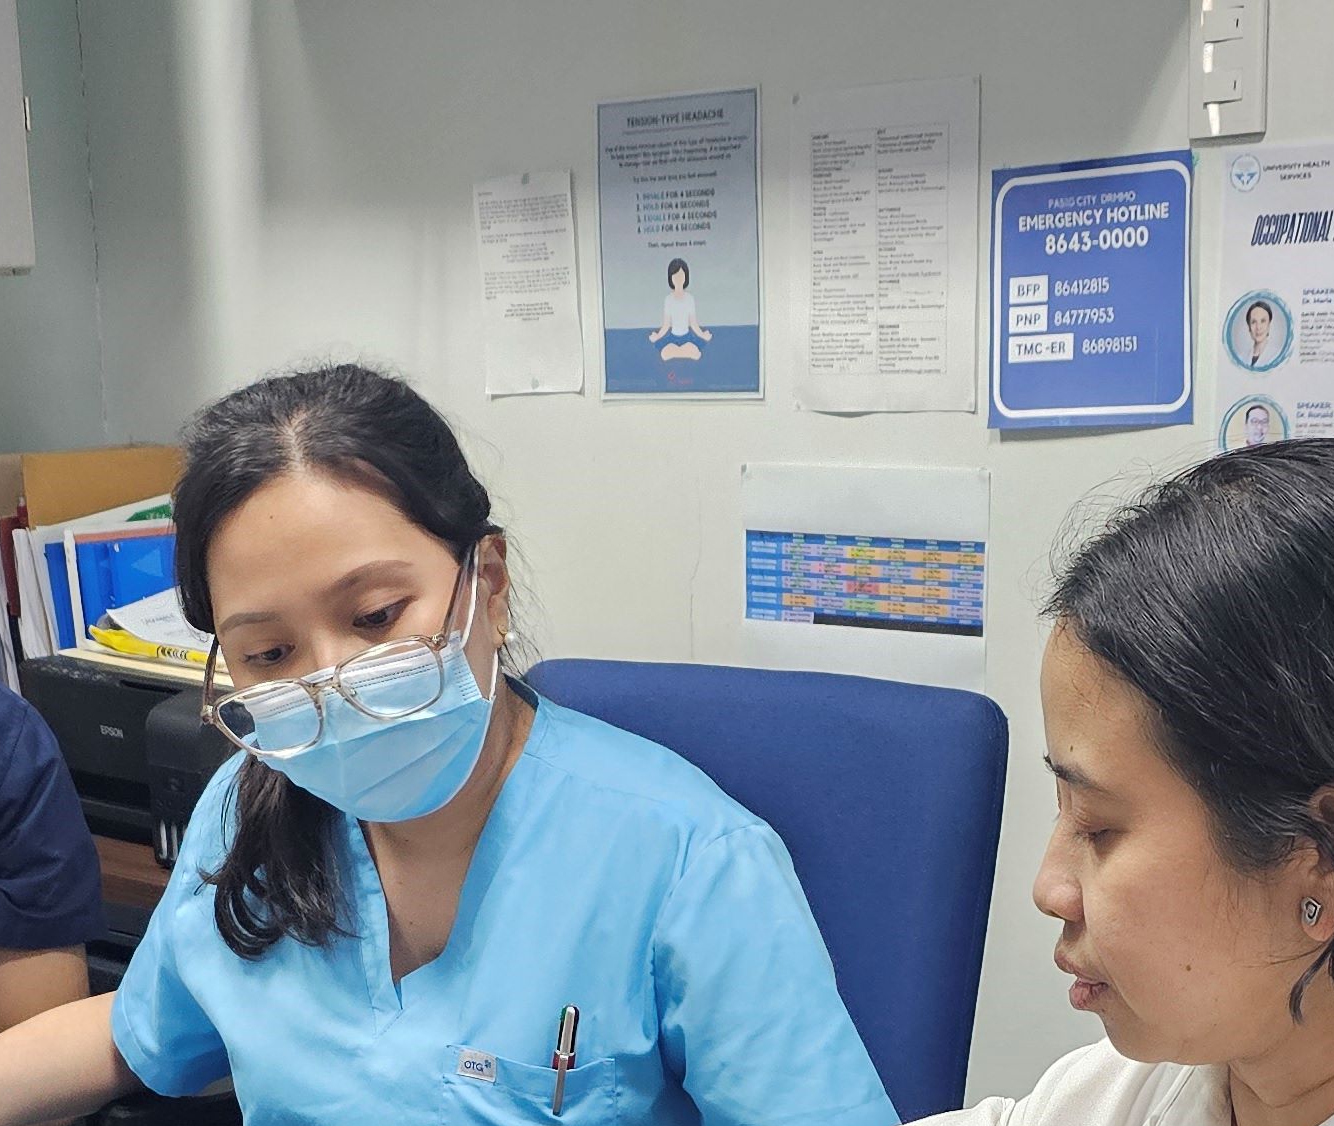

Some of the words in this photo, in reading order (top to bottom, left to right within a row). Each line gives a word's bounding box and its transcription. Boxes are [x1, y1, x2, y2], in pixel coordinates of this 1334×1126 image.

[681, 108, 724, 123] HEADACHE
[1303, 160, 1331, 170] HEALTH
[1279, 172, 1311, 181] SERVICES
[667, 190, 678, 199] FOR
[686, 188, 715, 198] SECONDS
[1077, 194, 1097, 206] CITY
[661, 202, 673, 210] FOR
[681, 200, 709, 208] SECONDS
[667, 212, 680, 220] FOR
[688, 210, 717, 219] SECONDS
[1019, 208, 1103, 232] EMERGENCY
[1107, 202, 1169, 224] HOTLINE
[661, 224, 673, 232] FOR
[681, 222, 711, 232] SECONDS
[1251, 210, 1334, 247] OCCUPATIONAL
[1045, 226, 1149, 256] 8643-0000
[1017, 284, 1041, 296] BFP
[1055, 277, 1109, 296] 86412815
[1017, 314, 1041, 327] PNP
[1055, 307, 1115, 326] 84777953
[1082, 336, 1137, 354] 86898151
[99, 724, 124, 739] EPSON
[465, 1060, 484, 1072] OTG
